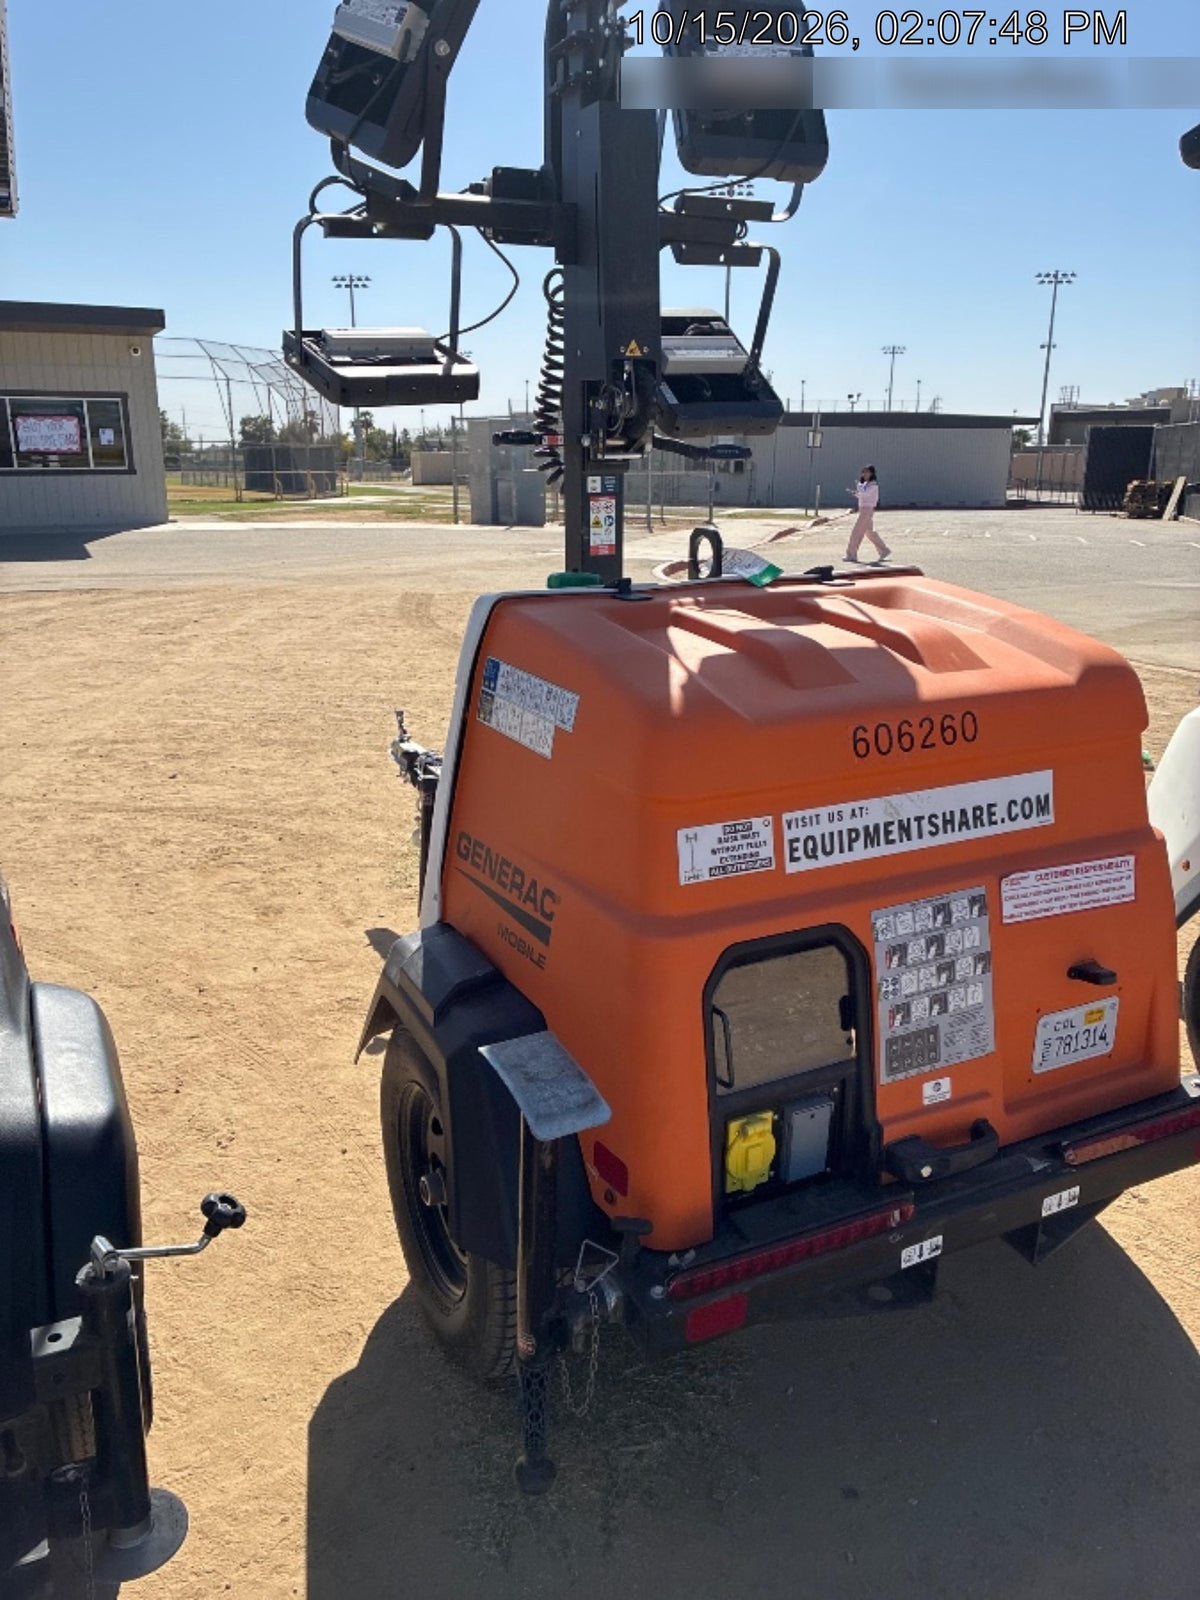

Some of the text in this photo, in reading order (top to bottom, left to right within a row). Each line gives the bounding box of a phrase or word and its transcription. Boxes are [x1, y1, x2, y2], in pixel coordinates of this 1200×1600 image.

[853, 710, 979, 758] 606260
[785, 806, 869, 831] VISIT US AT:
[788, 793, 1052, 864] EQUIPMENTSHARE.COM
[456, 831, 557, 922] GENERAC
[497, 923, 547, 970] MOBILE
[1054, 1023, 1108, 1057] 781314
